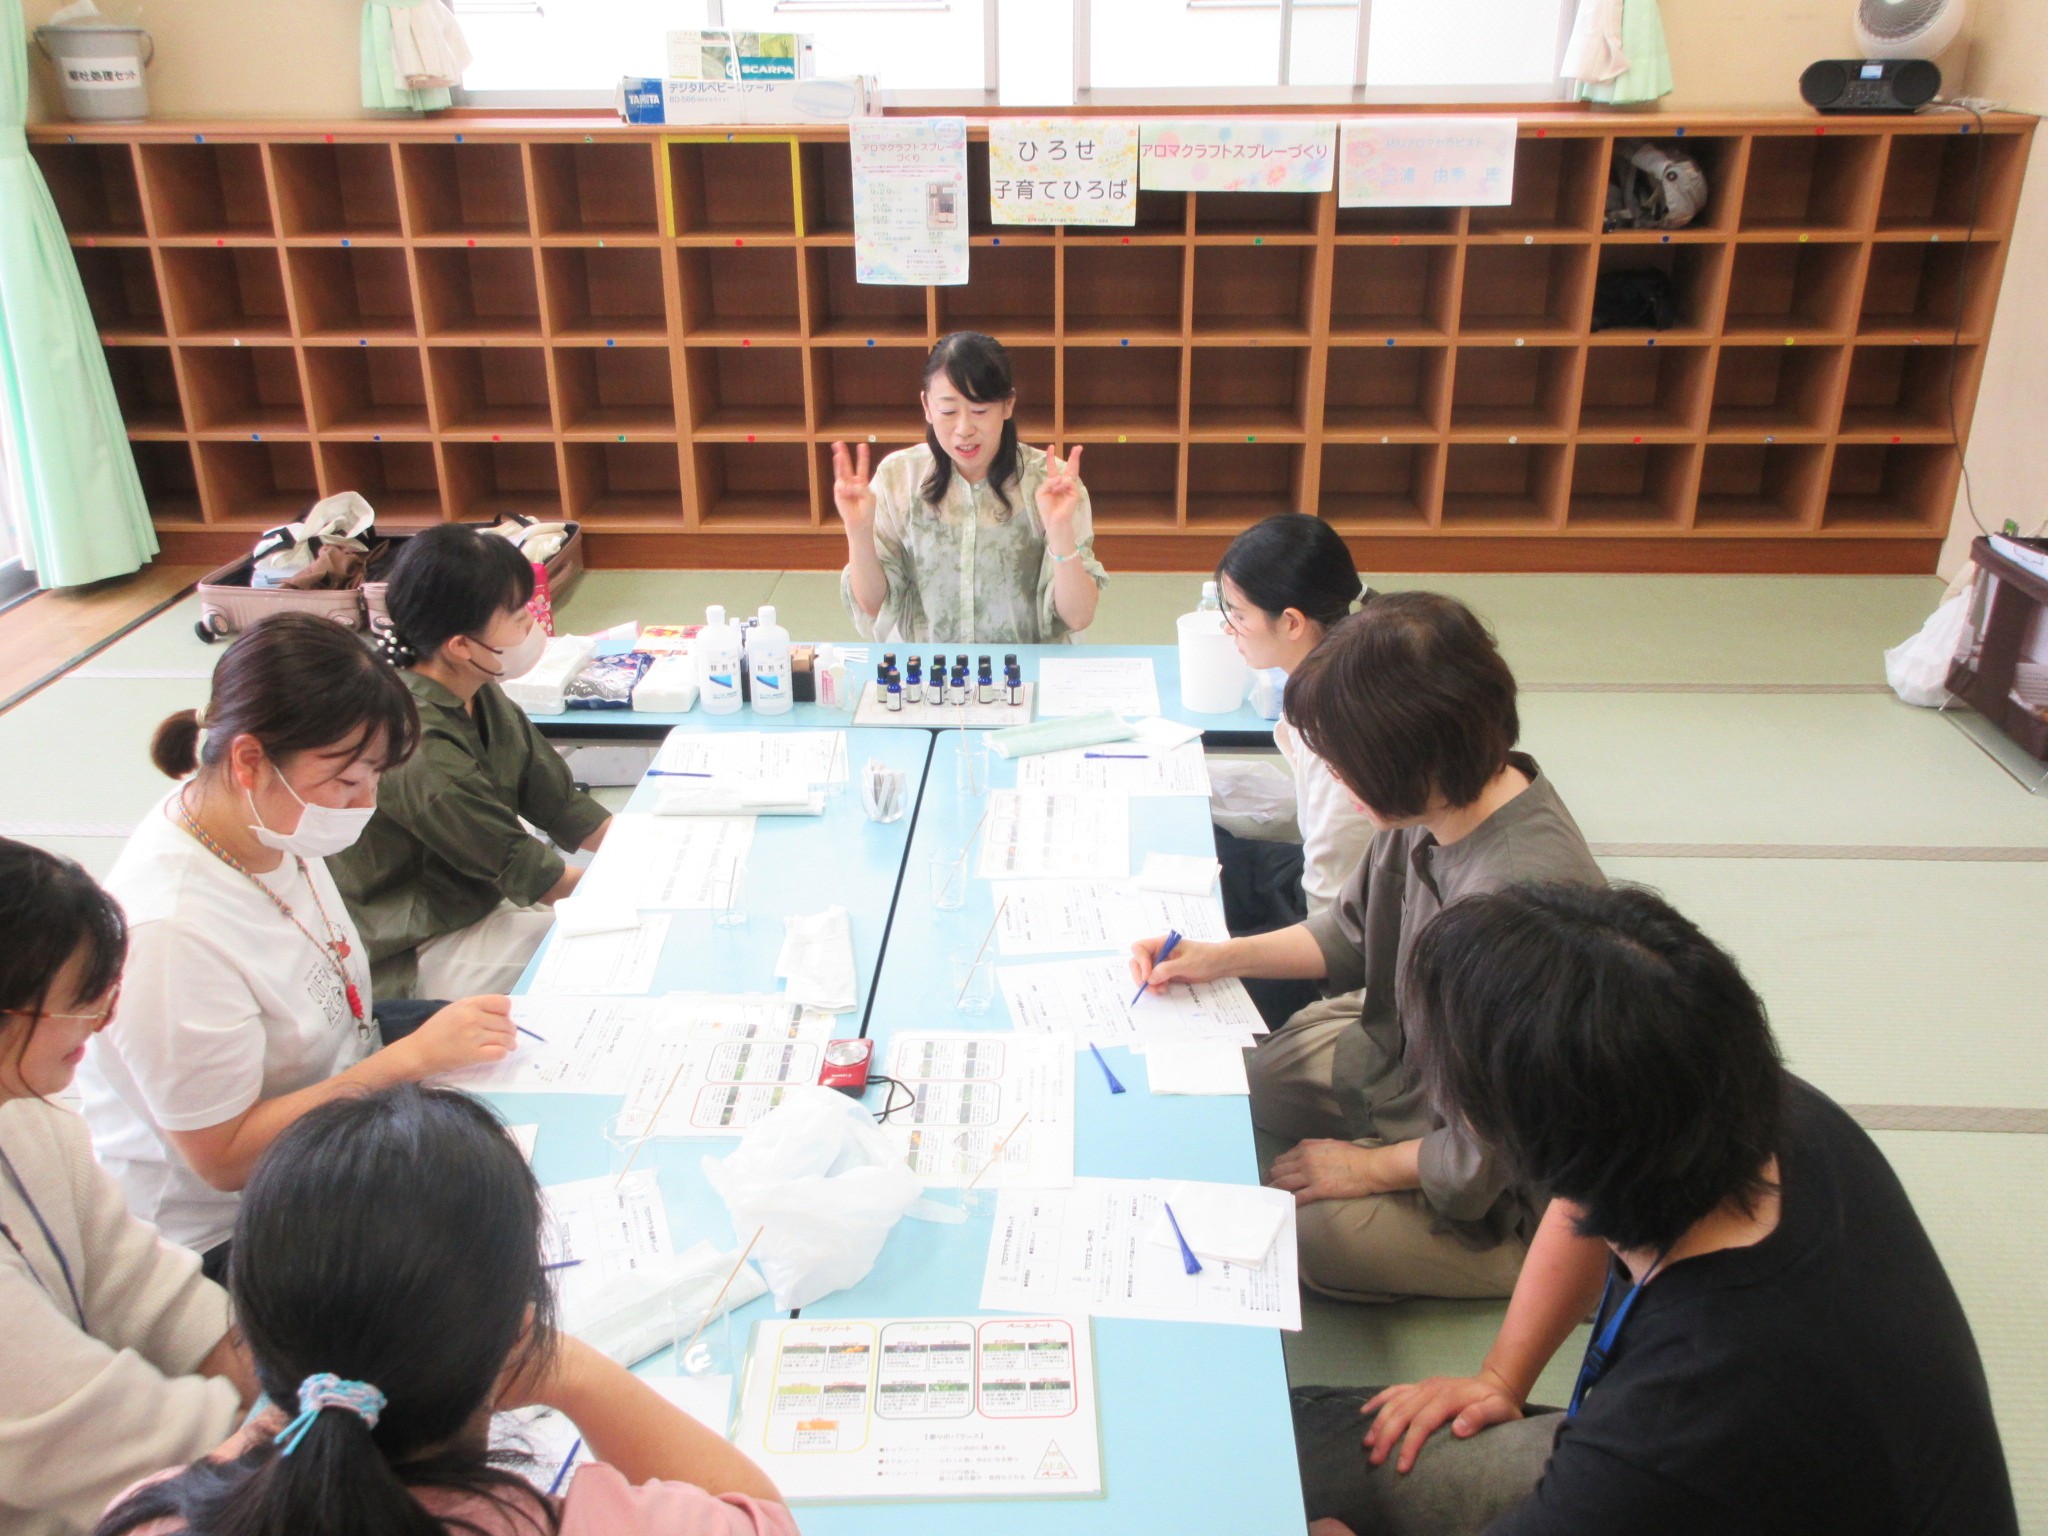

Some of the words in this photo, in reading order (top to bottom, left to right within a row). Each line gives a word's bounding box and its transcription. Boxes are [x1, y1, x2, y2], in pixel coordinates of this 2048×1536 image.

[742, 65, 794, 75] SCARPA
[628, 94, 660, 105] TANITA
[1019, 139, 1096, 162] ひろせ
[1140, 143, 1328, 160] アロマクラフトスプレーづくり
[993, 178, 1129, 200] 子育てひろば
